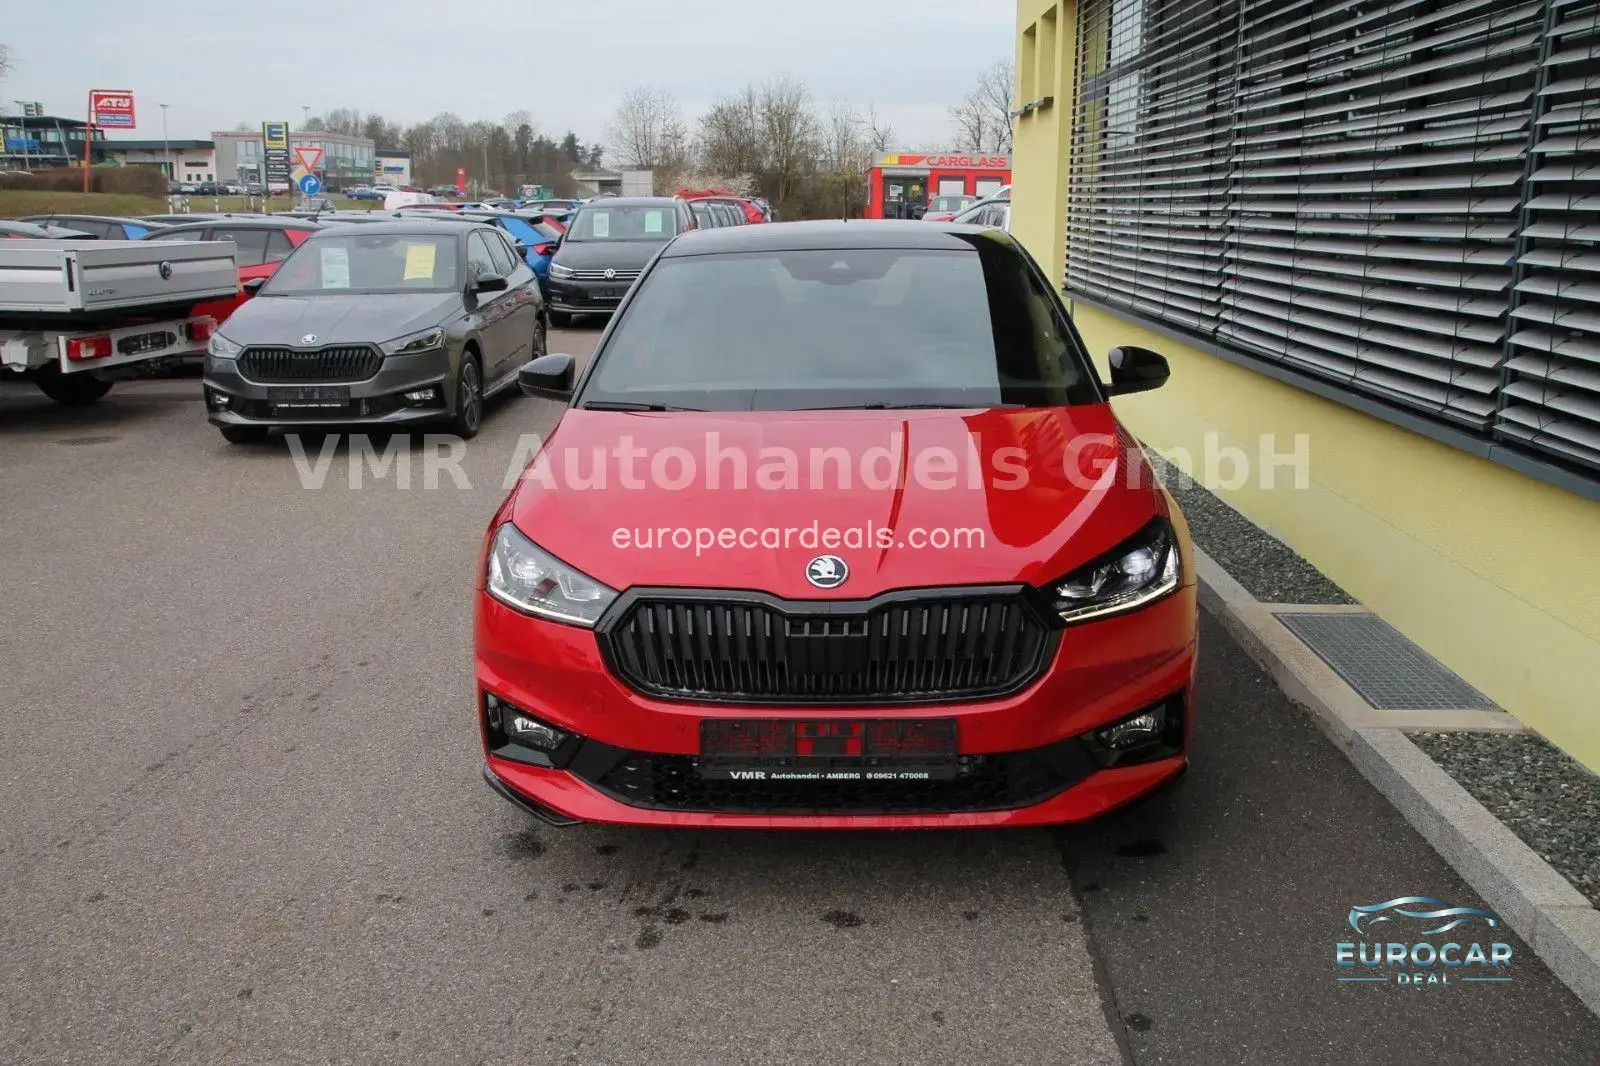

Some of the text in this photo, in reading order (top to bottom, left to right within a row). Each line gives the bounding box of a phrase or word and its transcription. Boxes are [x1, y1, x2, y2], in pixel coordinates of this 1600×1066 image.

[267, 124, 284, 141] E
[926, 155, 1007, 167] CARGLASS
[730, 771, 766, 780] VMR
